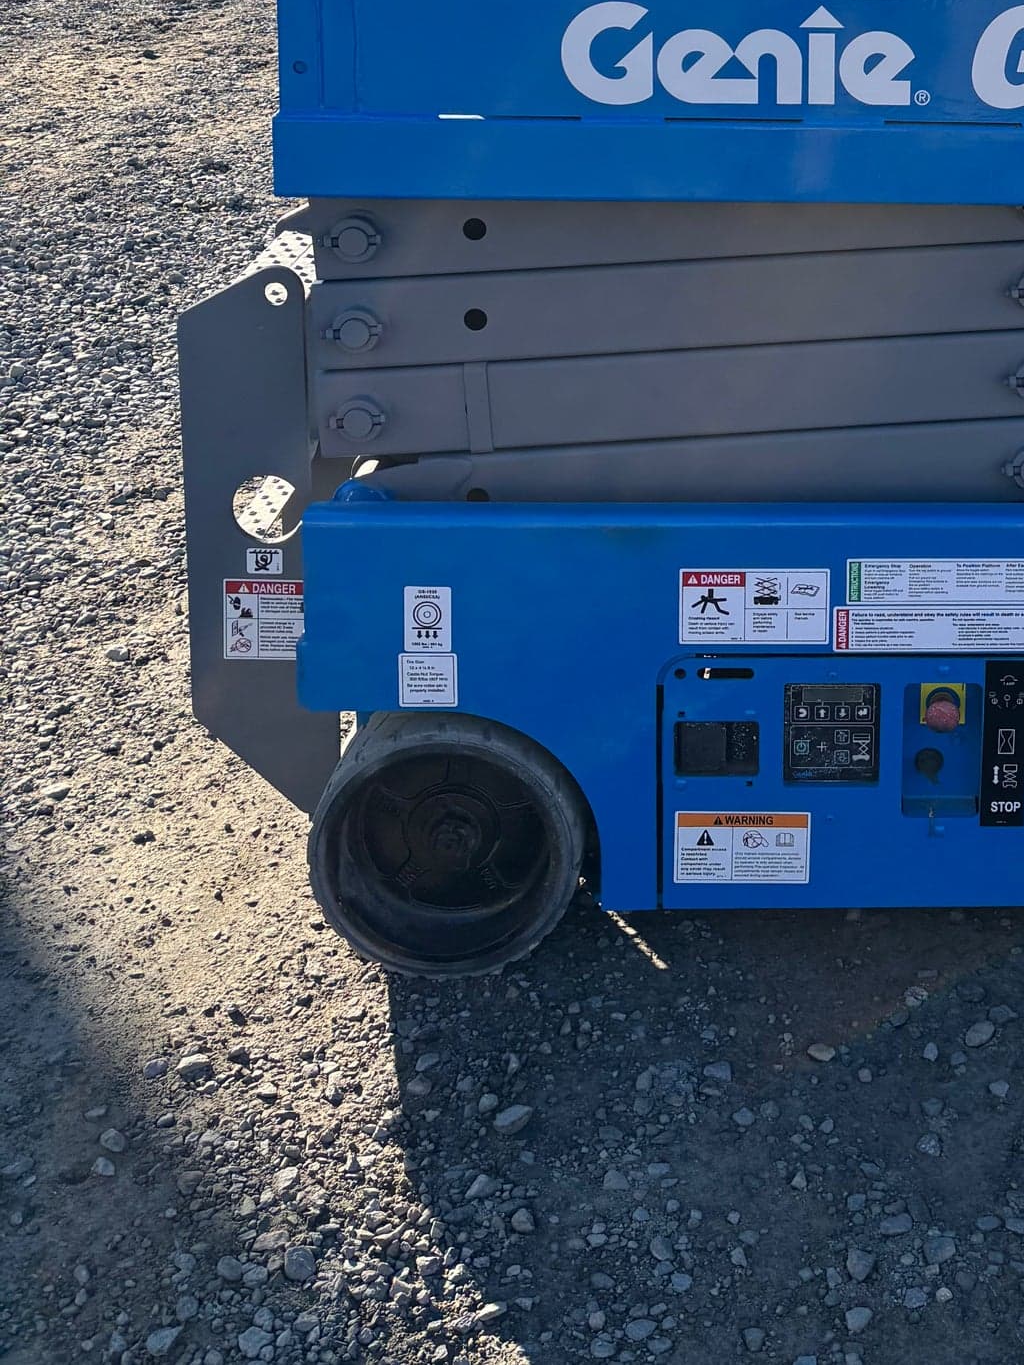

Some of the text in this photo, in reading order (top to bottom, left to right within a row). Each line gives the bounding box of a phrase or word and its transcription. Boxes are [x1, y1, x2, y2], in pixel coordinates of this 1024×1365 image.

[561, 1, 916, 106] Genie
[700, 574, 740, 584] DANGER
[851, 563, 859, 601] INSTRUCTIONS
[252, 583, 296, 594] DANGER
[838, 611, 847, 642] DANGER
[990, 801, 1021, 812] STOP
[725, 816, 773, 825] WARNING
